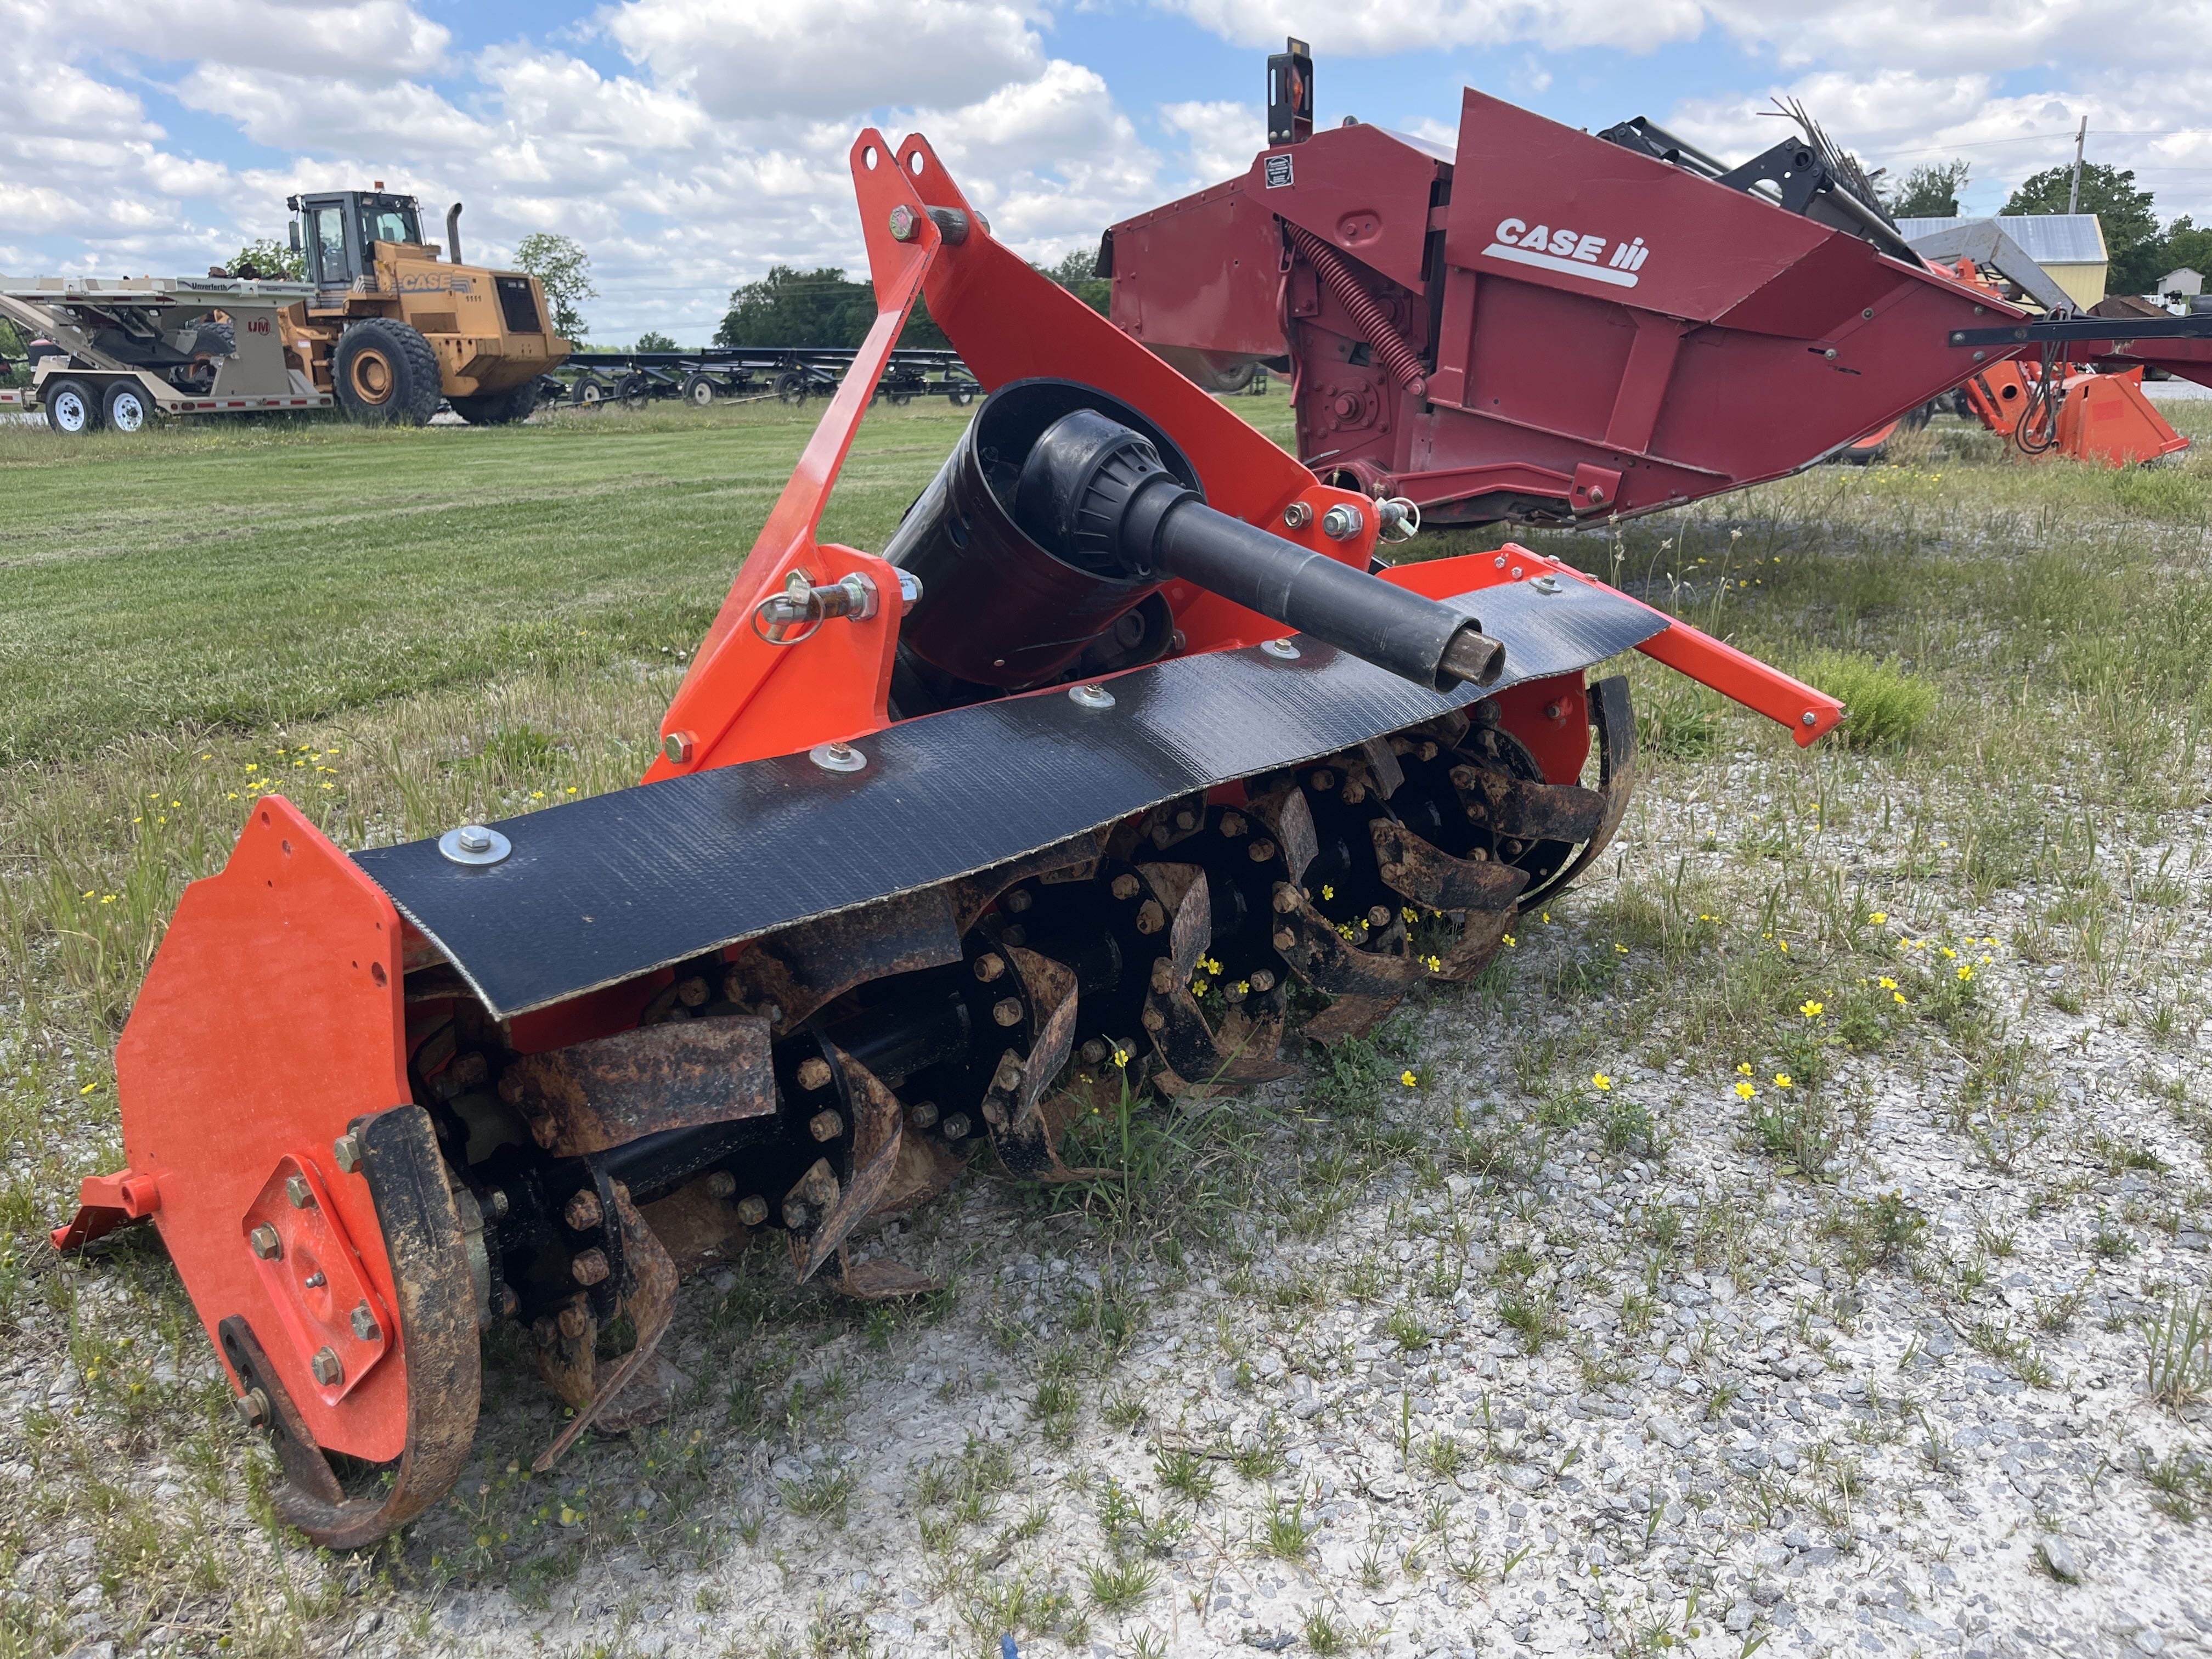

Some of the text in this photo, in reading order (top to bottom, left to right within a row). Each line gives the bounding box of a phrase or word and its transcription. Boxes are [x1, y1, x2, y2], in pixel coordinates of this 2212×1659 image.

[1495, 218, 1607, 263] CASE
[192, 282, 227, 291] Unverferth
[403, 274, 452, 290] CASE
